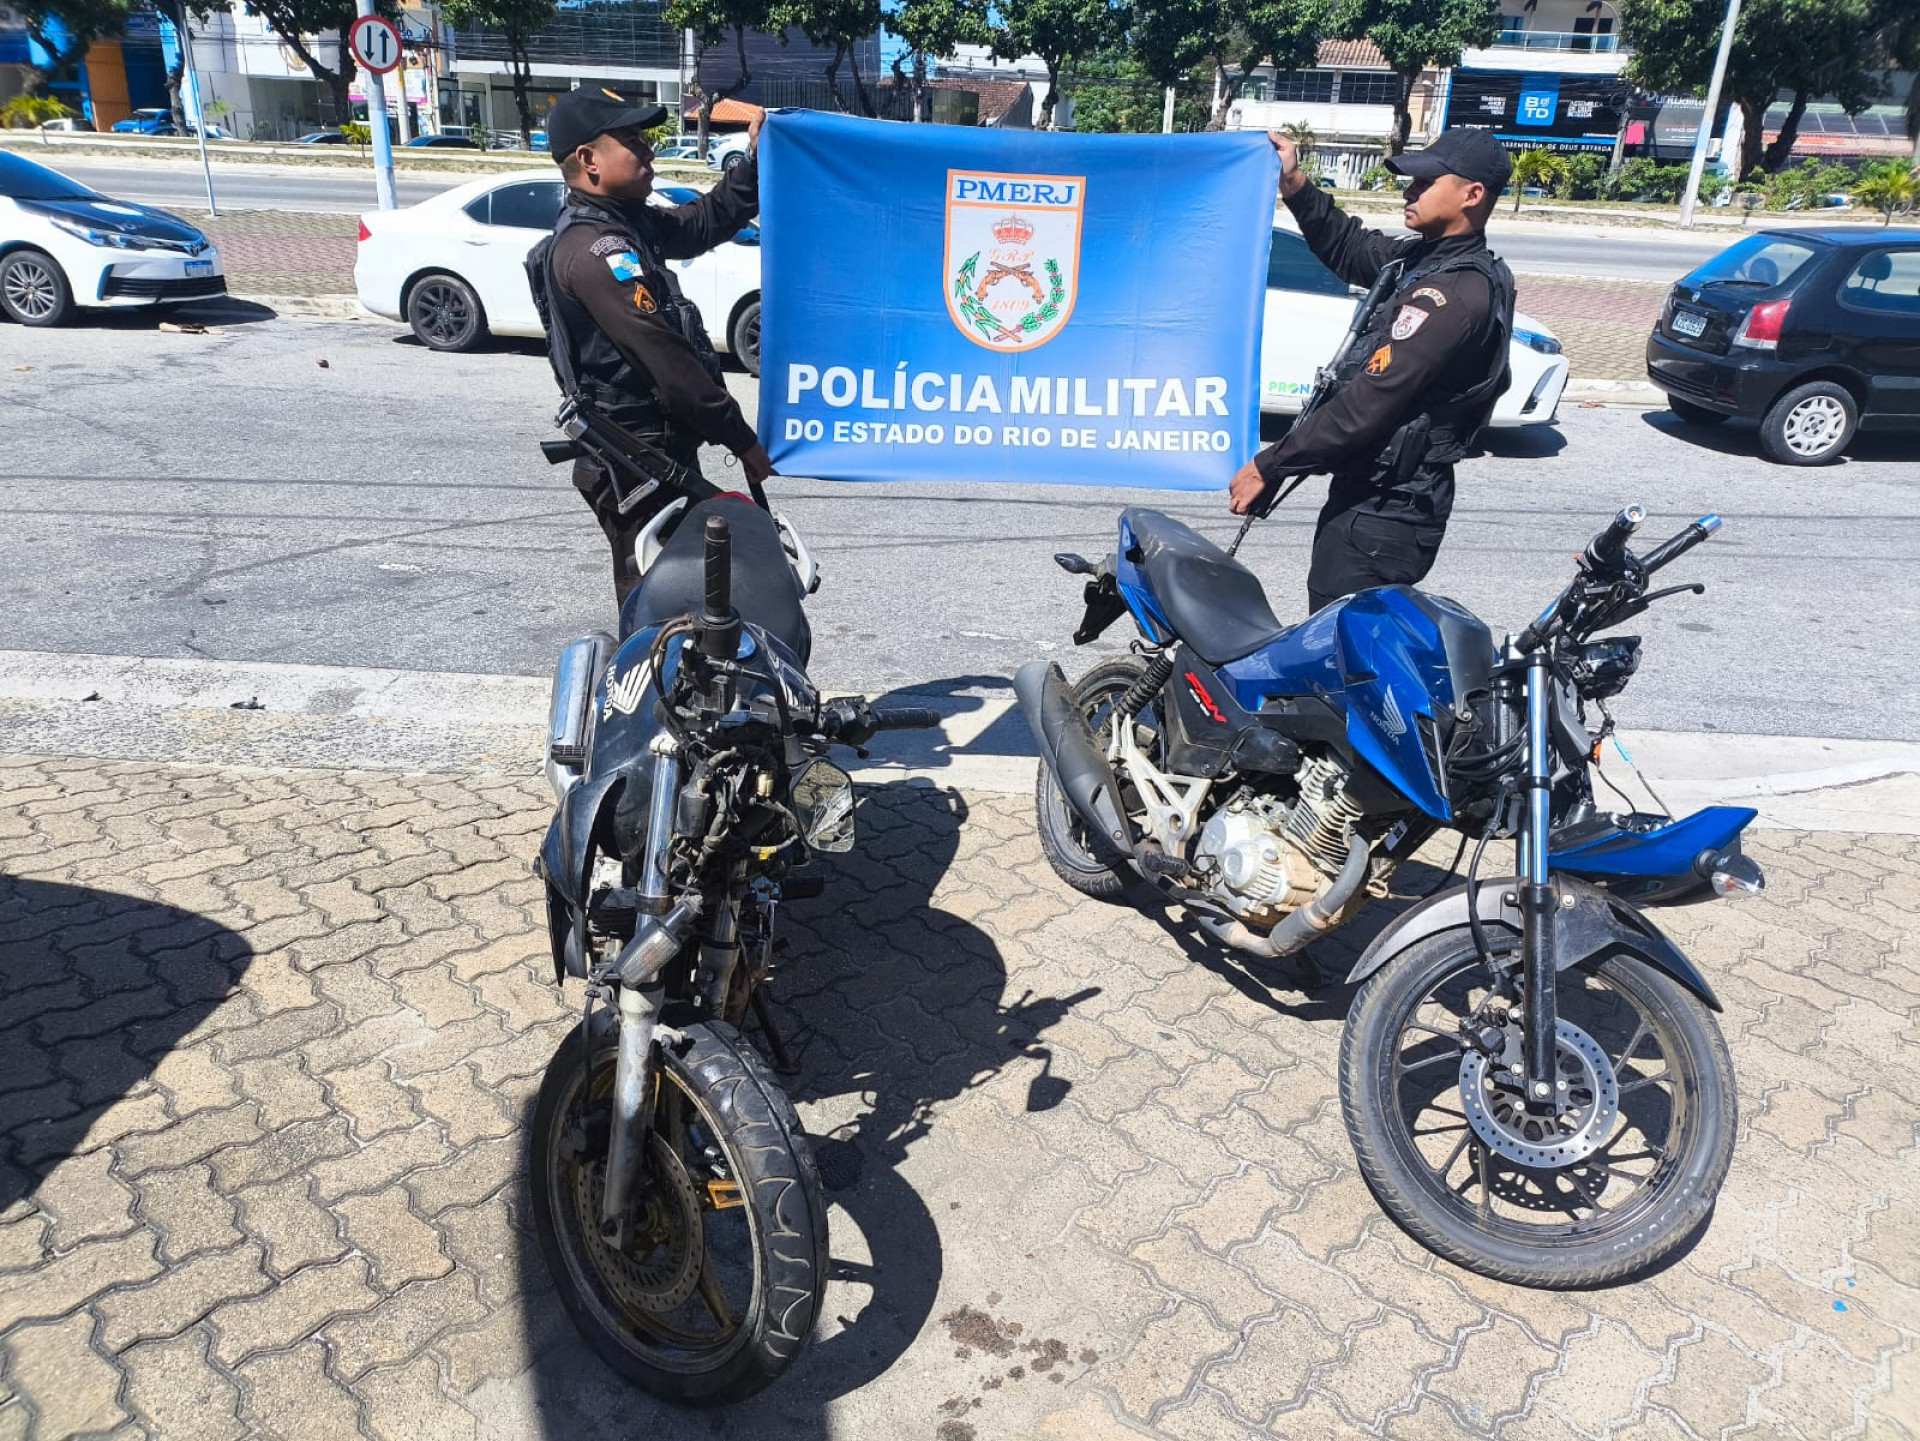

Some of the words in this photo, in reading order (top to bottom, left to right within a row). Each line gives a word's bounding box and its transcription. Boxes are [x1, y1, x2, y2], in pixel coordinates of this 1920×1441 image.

[957, 179, 1075, 204] PMERJ
[787, 360, 1003, 414] POLÍCIA
[1009, 376, 1230, 417] MILITAR
[785, 418, 824, 441] DO
[833, 420, 944, 445] ESTADO
[954, 424, 993, 446] DO
[1002, 426, 1051, 446] RIO
[1061, 427, 1098, 449] DE
[1105, 429, 1231, 452] JANEIRO
[603, 664, 617, 723] HONDA
[1369, 711, 1399, 746] HONDA
